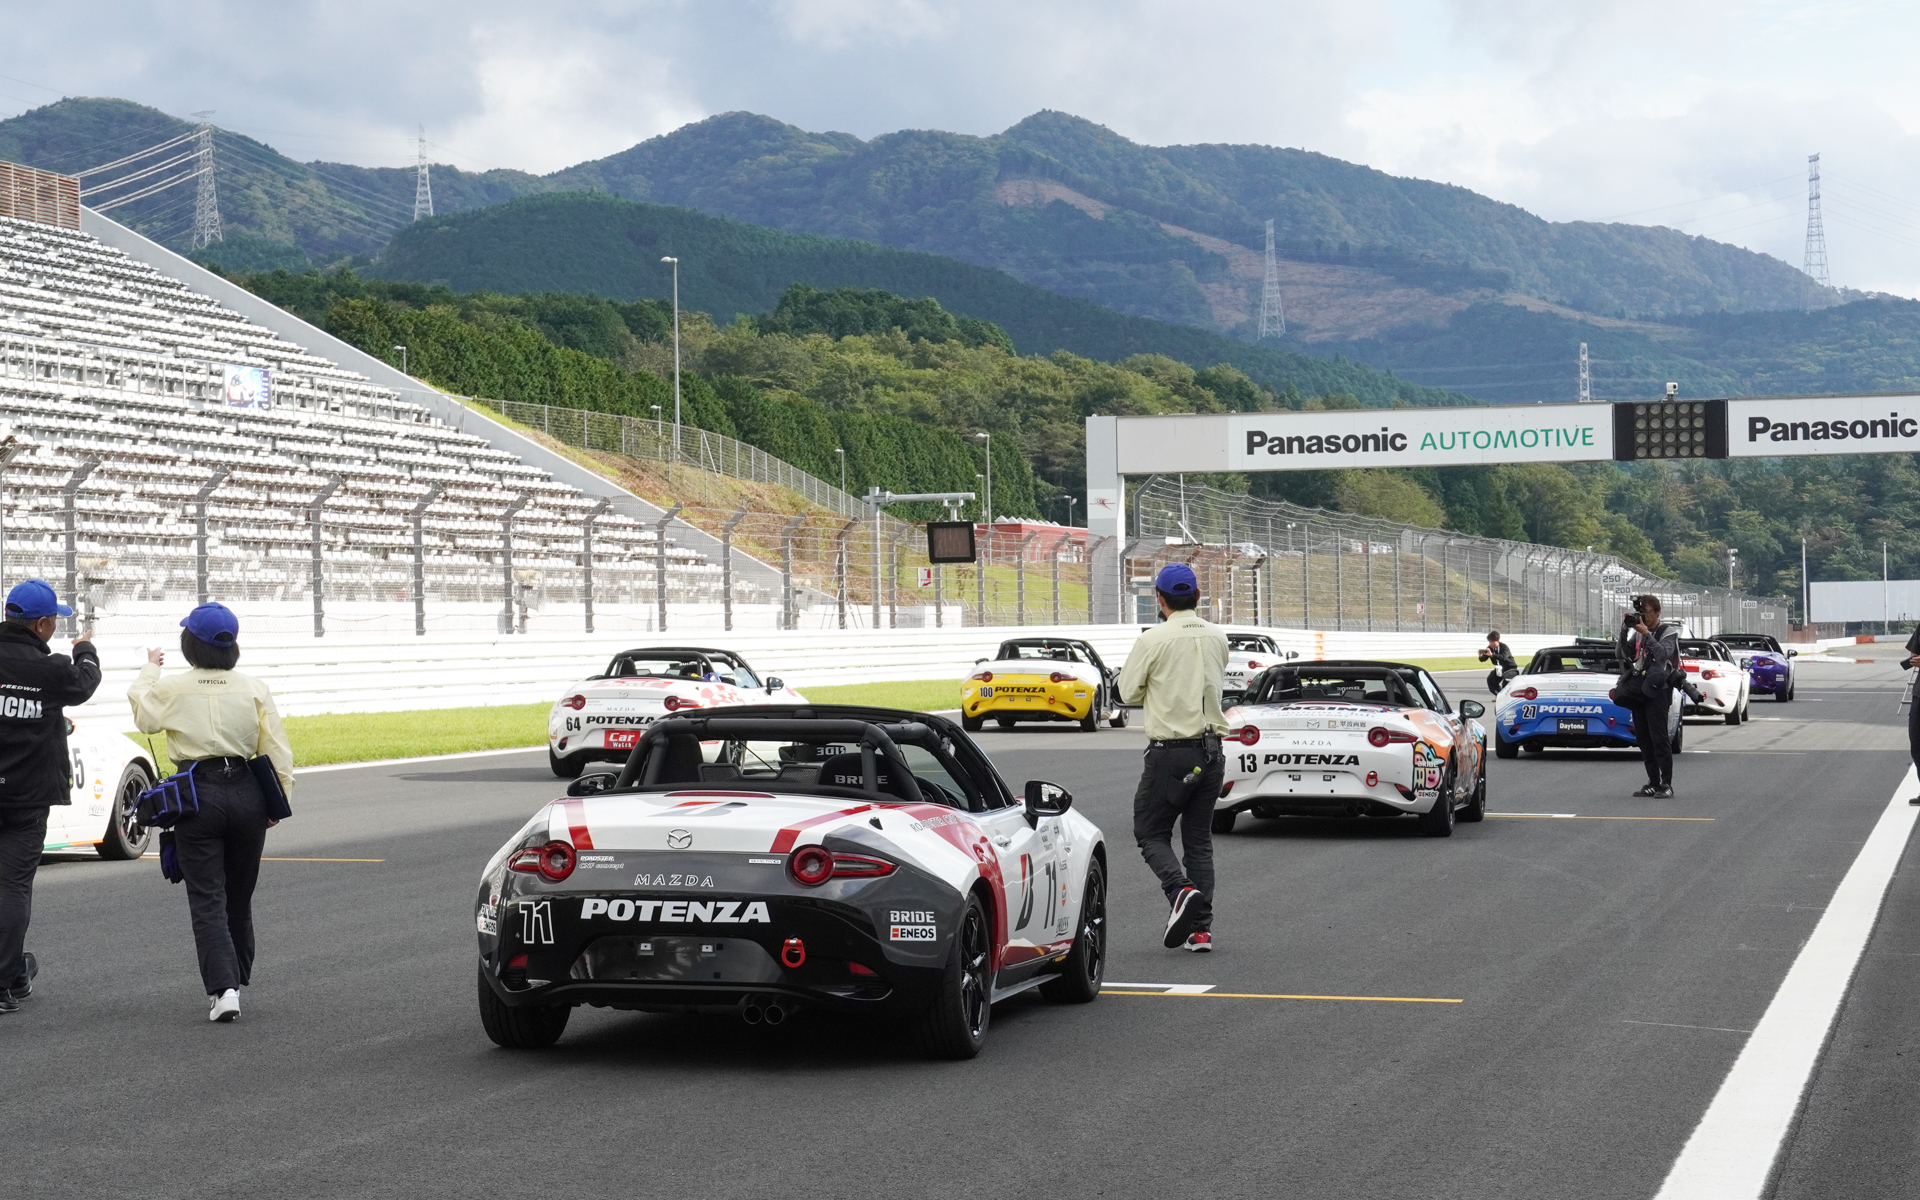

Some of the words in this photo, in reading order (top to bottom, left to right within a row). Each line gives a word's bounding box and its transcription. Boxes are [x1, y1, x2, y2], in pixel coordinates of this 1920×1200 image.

[1748, 412, 1918, 442] Panasonic
[1246, 427, 1408, 456] Panasonic
[1420, 427, 1594, 450] AUTOMOTIVE
[1602, 575, 1621, 583] 250
[0, 684, 41, 692] PEEDWAY
[980, 687, 993, 698] 100
[1522, 705, 1537, 719] 27
[1539, 705, 1603, 714] POTENZA
[566, 716, 581, 731] 64
[586, 716, 654, 724] POTENZA
[609, 733, 635, 742] Car
[1238, 754, 1257, 773] 13
[1264, 754, 1360, 766] POTENZA
[835, 774, 888, 785] BRIE
[634, 874, 714, 887] MAZDA
[1044, 860, 1056, 929] 71
[580, 898, 771, 923] POTENZA
[890, 910, 935, 923] BRIDE
[519, 901, 554, 944] 71
[900, 928, 934, 938] ENEOS
